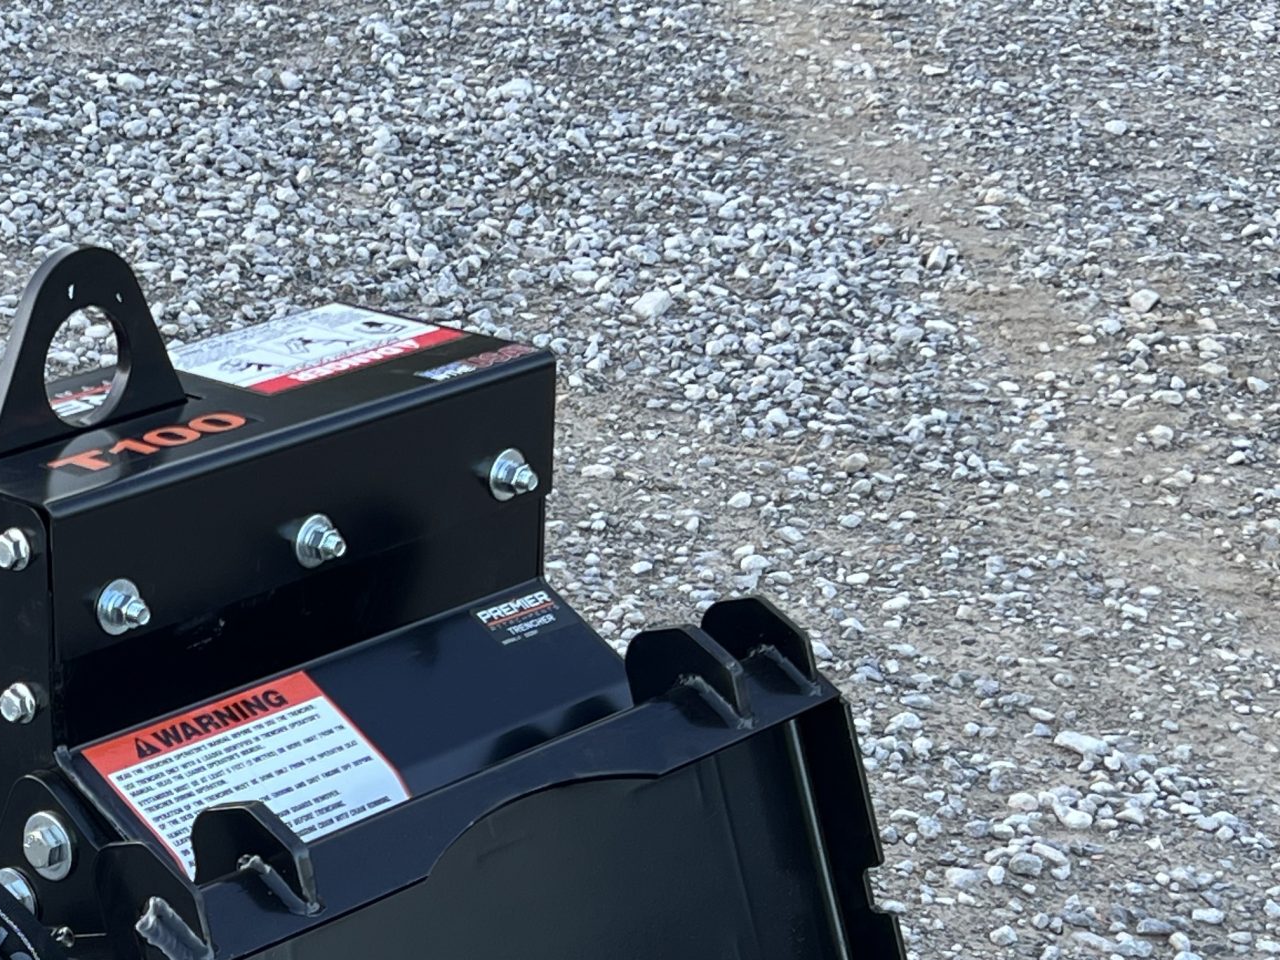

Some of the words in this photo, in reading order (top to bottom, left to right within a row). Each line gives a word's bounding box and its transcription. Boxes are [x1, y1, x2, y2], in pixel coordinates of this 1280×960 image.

[47, 413, 247, 471] T100
[476, 591, 552, 624] PREMIER
[506, 613, 556, 635] TRENCHER
[152, 689, 289, 749] WARNING
